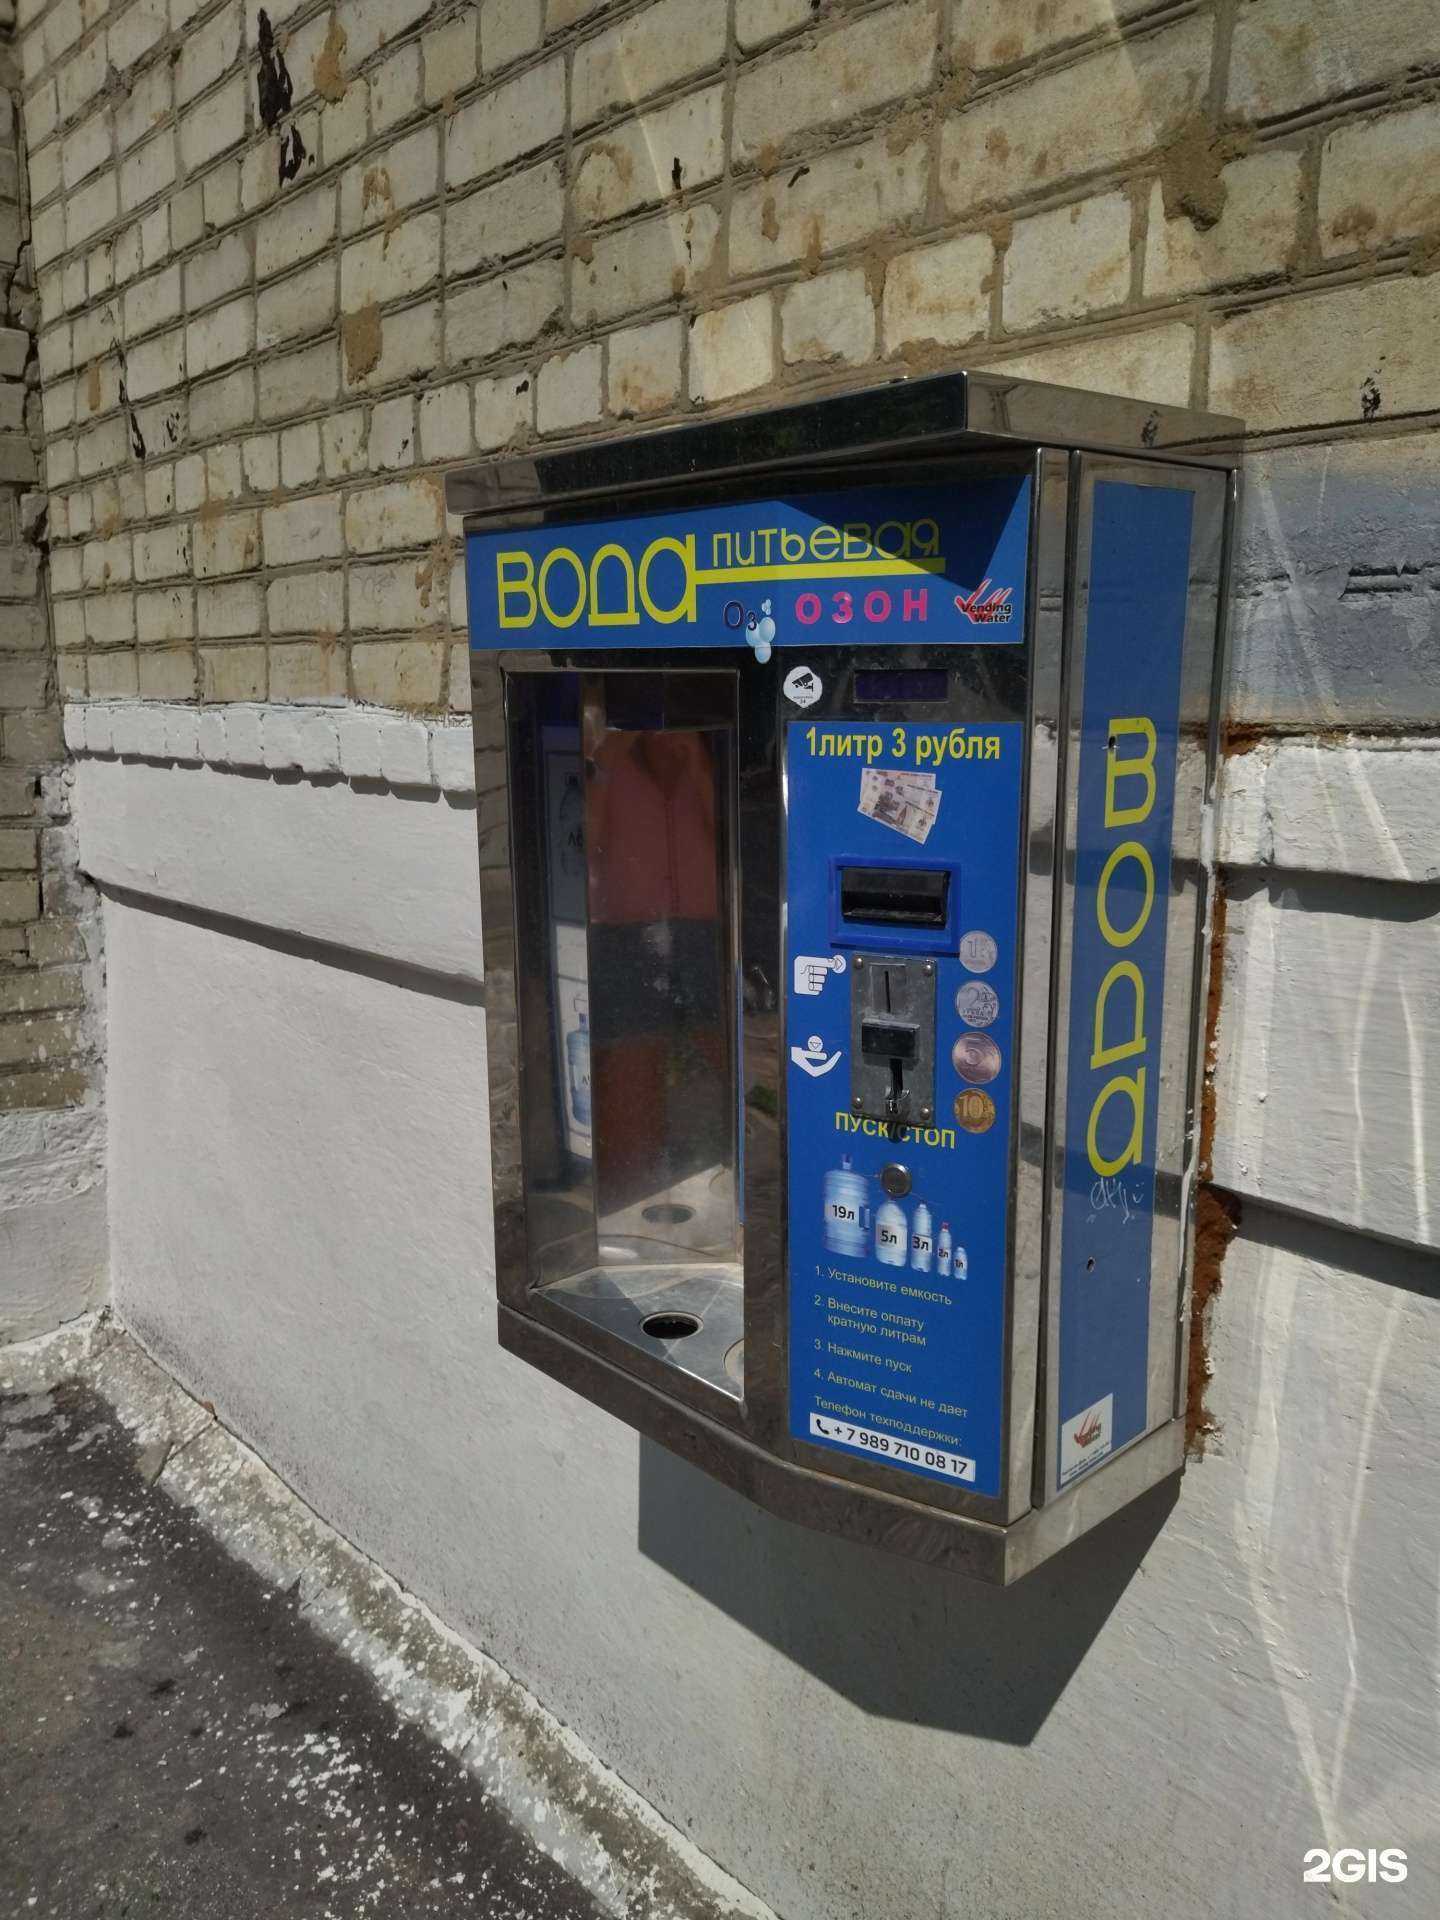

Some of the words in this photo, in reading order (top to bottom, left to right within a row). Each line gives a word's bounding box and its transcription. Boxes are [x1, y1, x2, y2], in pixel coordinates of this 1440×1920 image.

[712, 518, 940, 567] питьевая
[960, 601, 1013, 614] Vending
[974, 612, 1012, 624] Water
[805, 726, 883, 764] 1литр
[891, 728, 907, 759] 3
[915, 728, 1001, 767] рубля
[832, 1204, 855, 1221] 19л
[880, 1230, 897, 1245] 5л
[912, 1236, 929, 1252] 3л
[815, 1265, 824, 1277] 1.
[828, 1266, 897, 1293] Установите
[901, 1286, 952, 1306] емкость
[814, 1294, 825, 1306] 2.
[828, 1297, 878, 1319] Внесите
[881, 1312, 925, 1332] оплату
[827, 1314, 877, 1336] кратную
[881, 1326, 927, 1346] литрам
[814, 1338, 825, 1350] 3.
[828, 1342, 882, 1366] Нажмите
[885, 1358, 912, 1373] пуск
[813, 1367, 824, 1380] 4.
[827, 1371, 877, 1393] Автомат
[880, 1386, 917, 1405] сдачи
[920, 1397, 935, 1409] не
[938, 1402, 968, 1418] дает
[815, 1397, 867, 1420] Телефон
